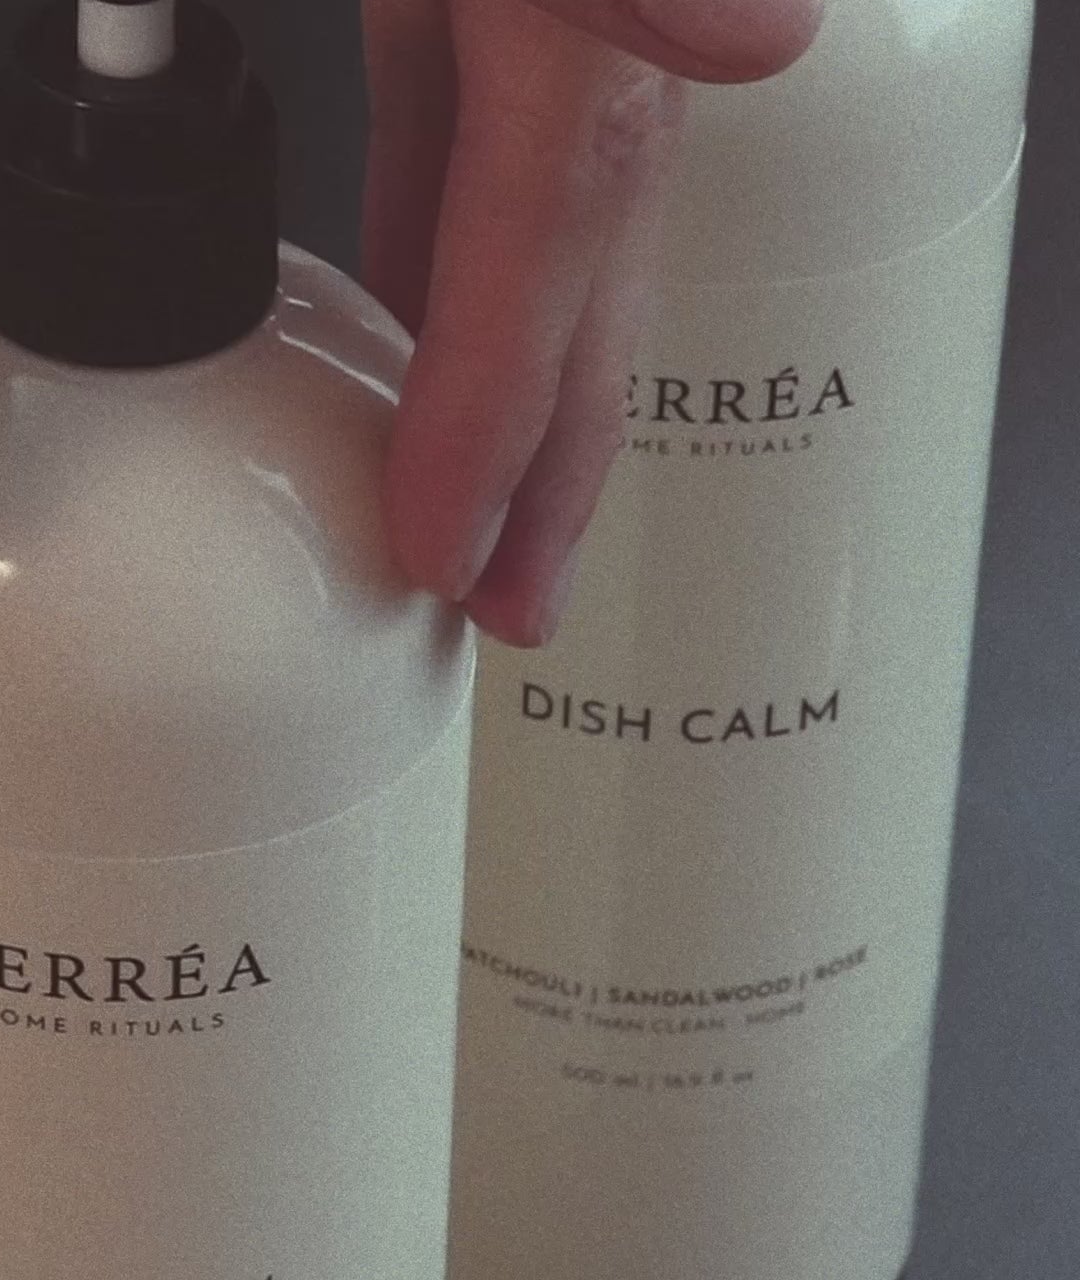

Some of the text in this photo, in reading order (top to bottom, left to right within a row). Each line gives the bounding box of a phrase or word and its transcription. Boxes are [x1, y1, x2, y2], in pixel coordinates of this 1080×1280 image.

[618, 433, 813, 457] ME RITUALS
[521, 682, 840, 744] DISH CALM
[608, 976, 793, 1008] SANDALWOOD
[89, 1012, 225, 1037] RITUALS
